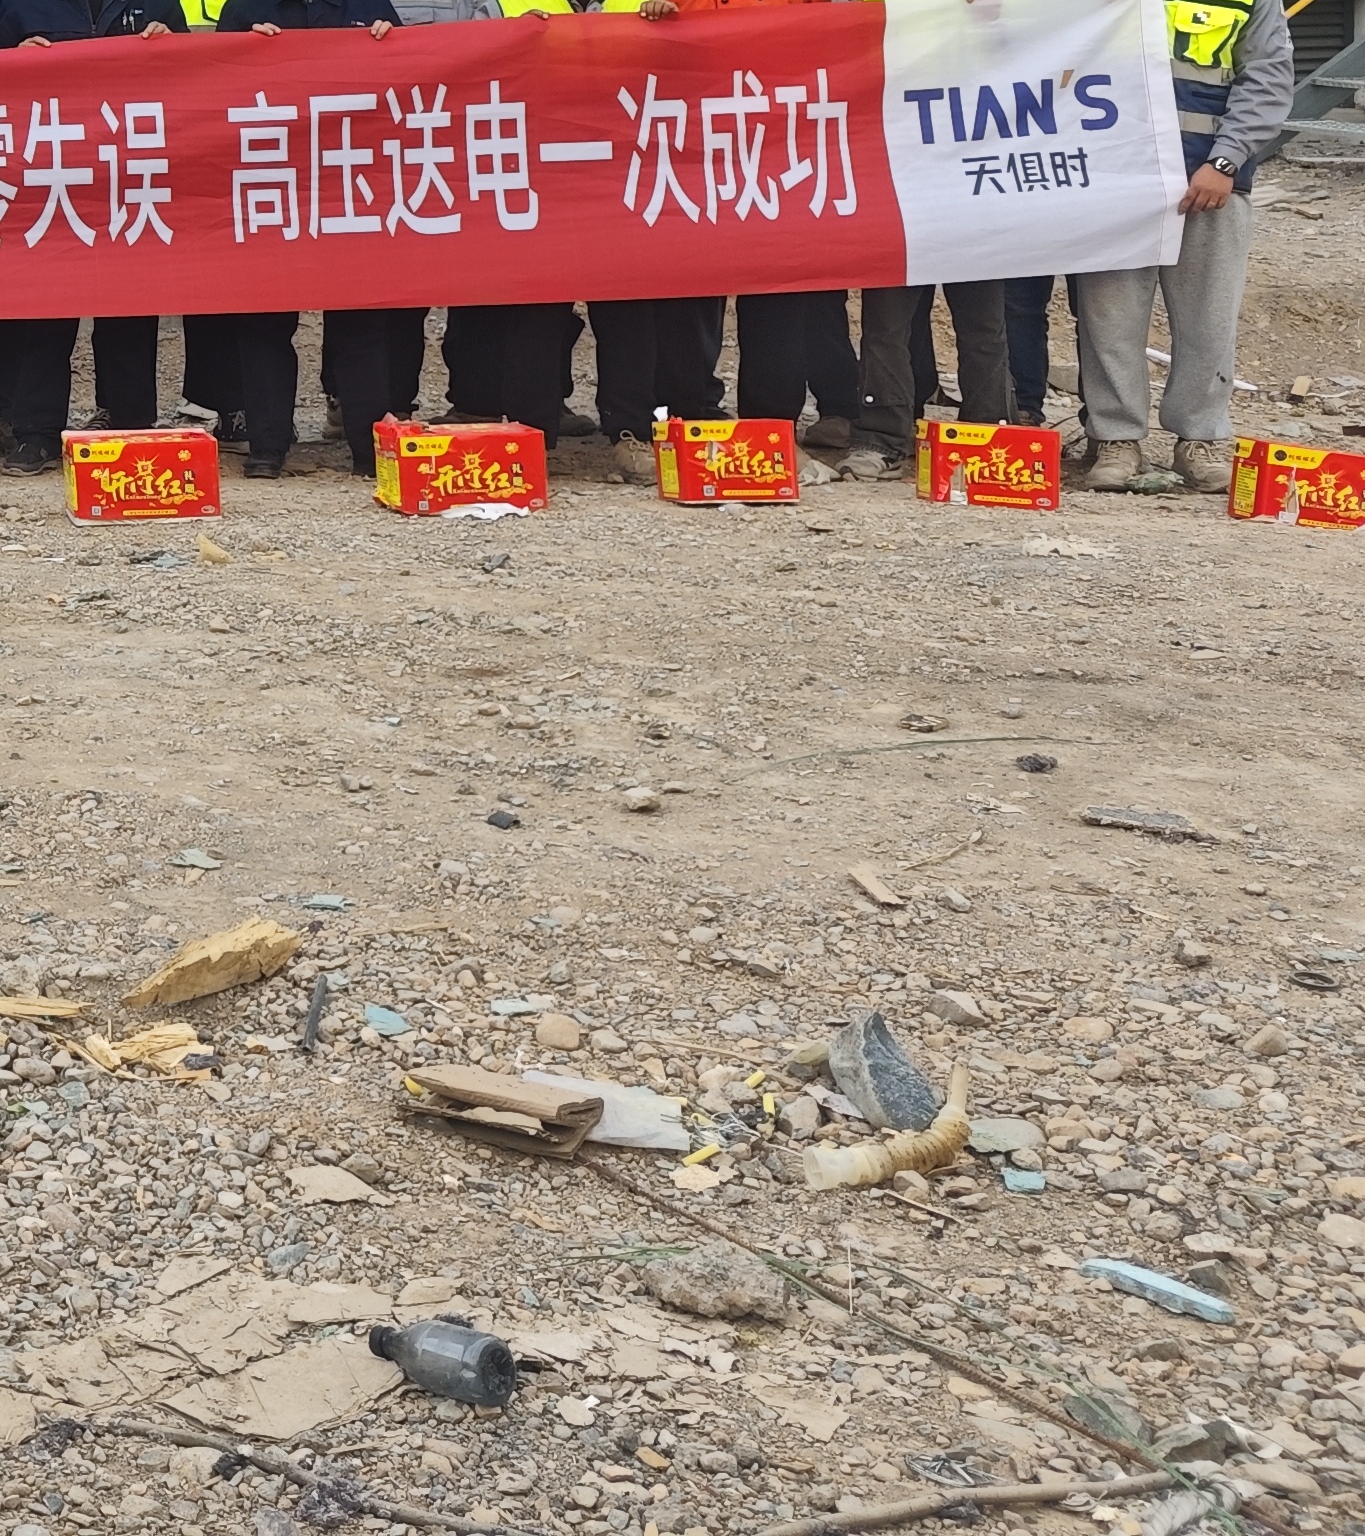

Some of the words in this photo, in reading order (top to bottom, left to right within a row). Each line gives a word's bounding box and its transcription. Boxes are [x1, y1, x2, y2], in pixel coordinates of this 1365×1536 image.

[904, 69, 1119, 144] TIAN'S
[227, 68, 859, 243] 高压送电一次成功
[962, 146, 1090, 196] 天俱时
[430, 454, 511, 496] 开门红
